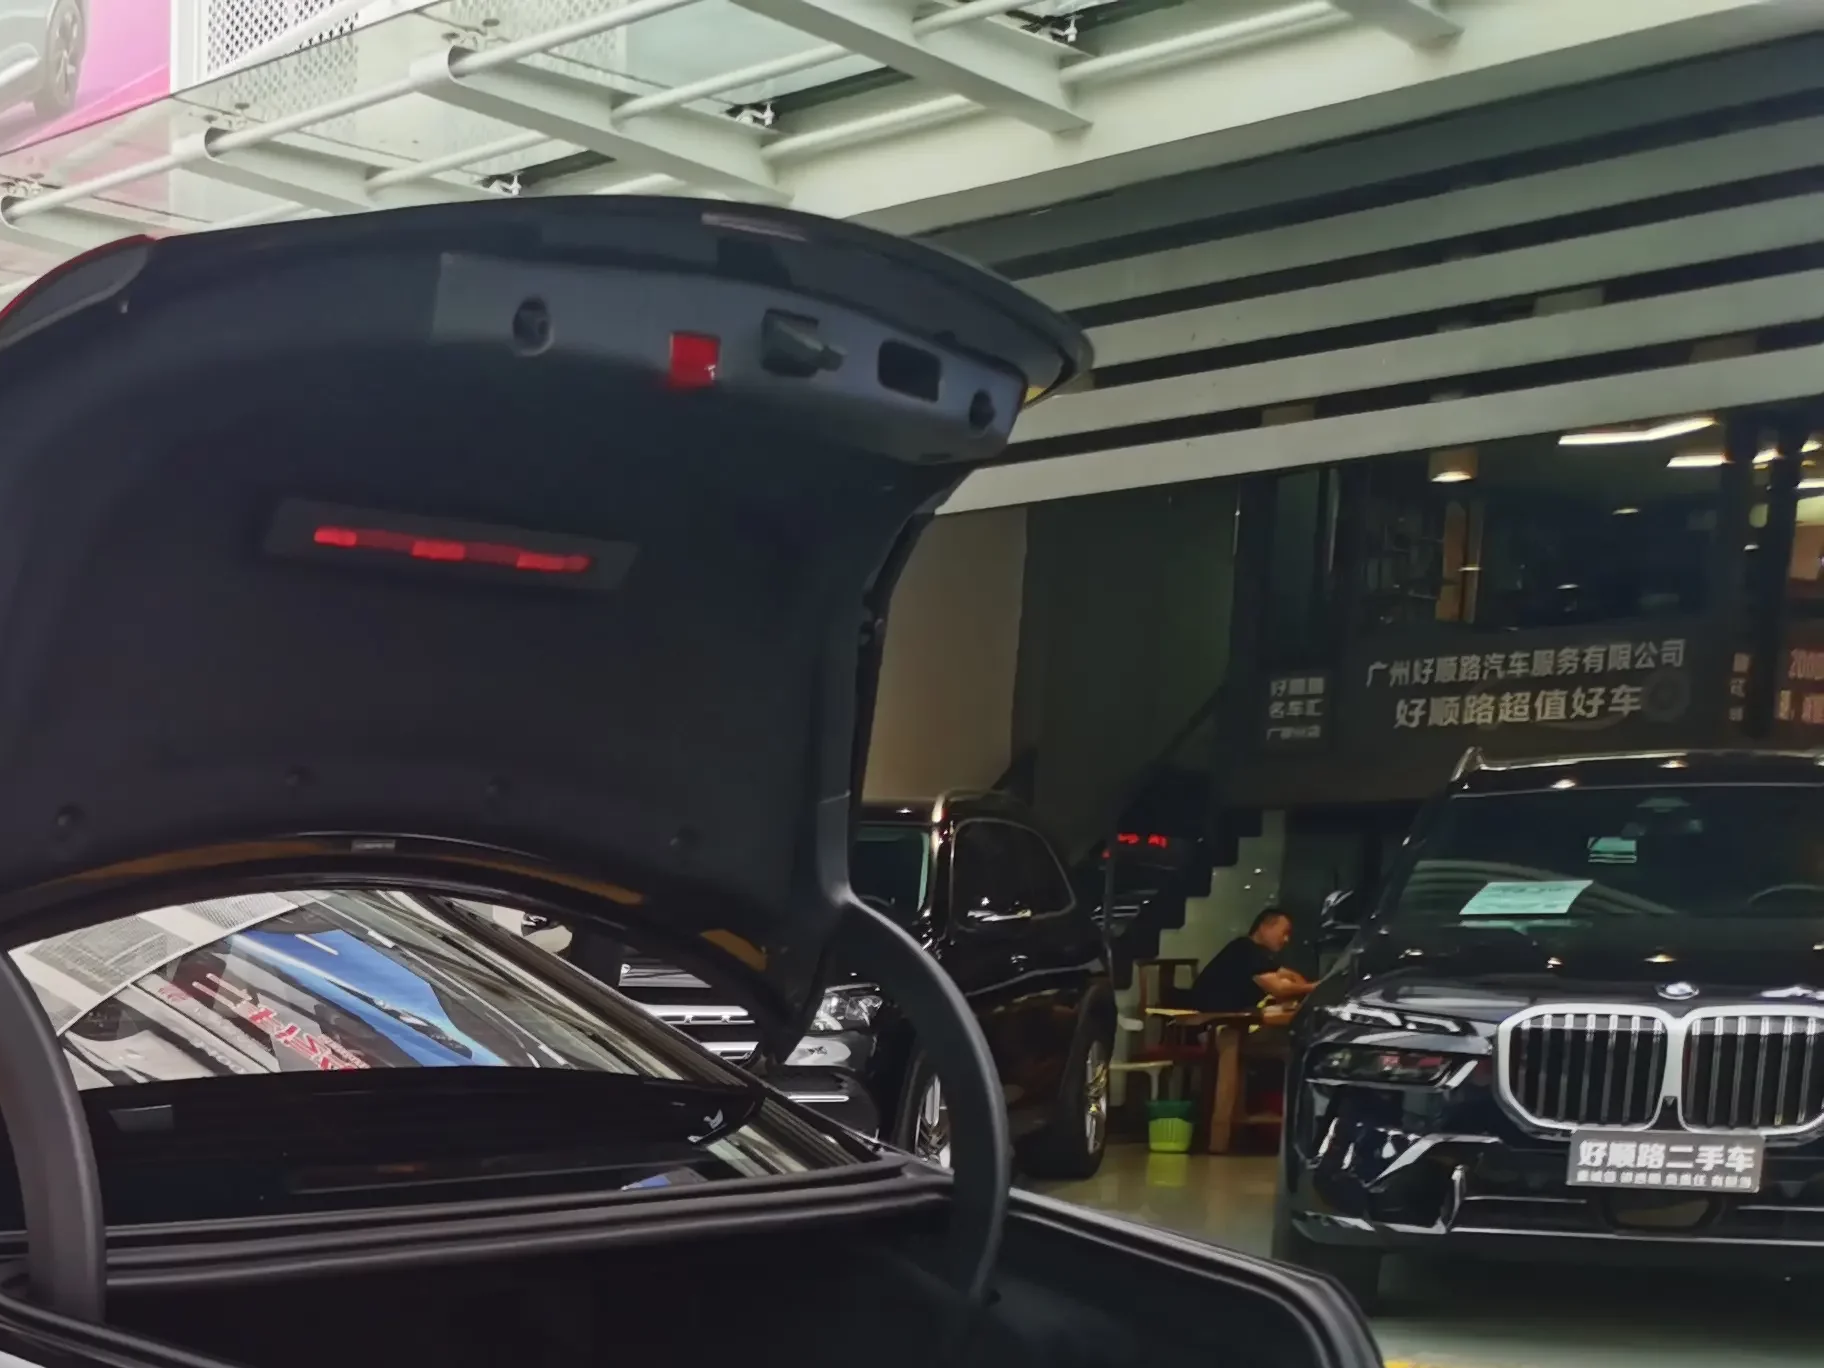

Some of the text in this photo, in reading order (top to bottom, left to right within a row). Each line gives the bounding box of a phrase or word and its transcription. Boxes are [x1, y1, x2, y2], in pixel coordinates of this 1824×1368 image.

[1365, 638, 1687, 689] 广州好顺路汽车服务有限公司
[1393, 684, 1644, 730] 好顺路超值好车
[1577, 1139, 1756, 1173] 好顺路二手车
